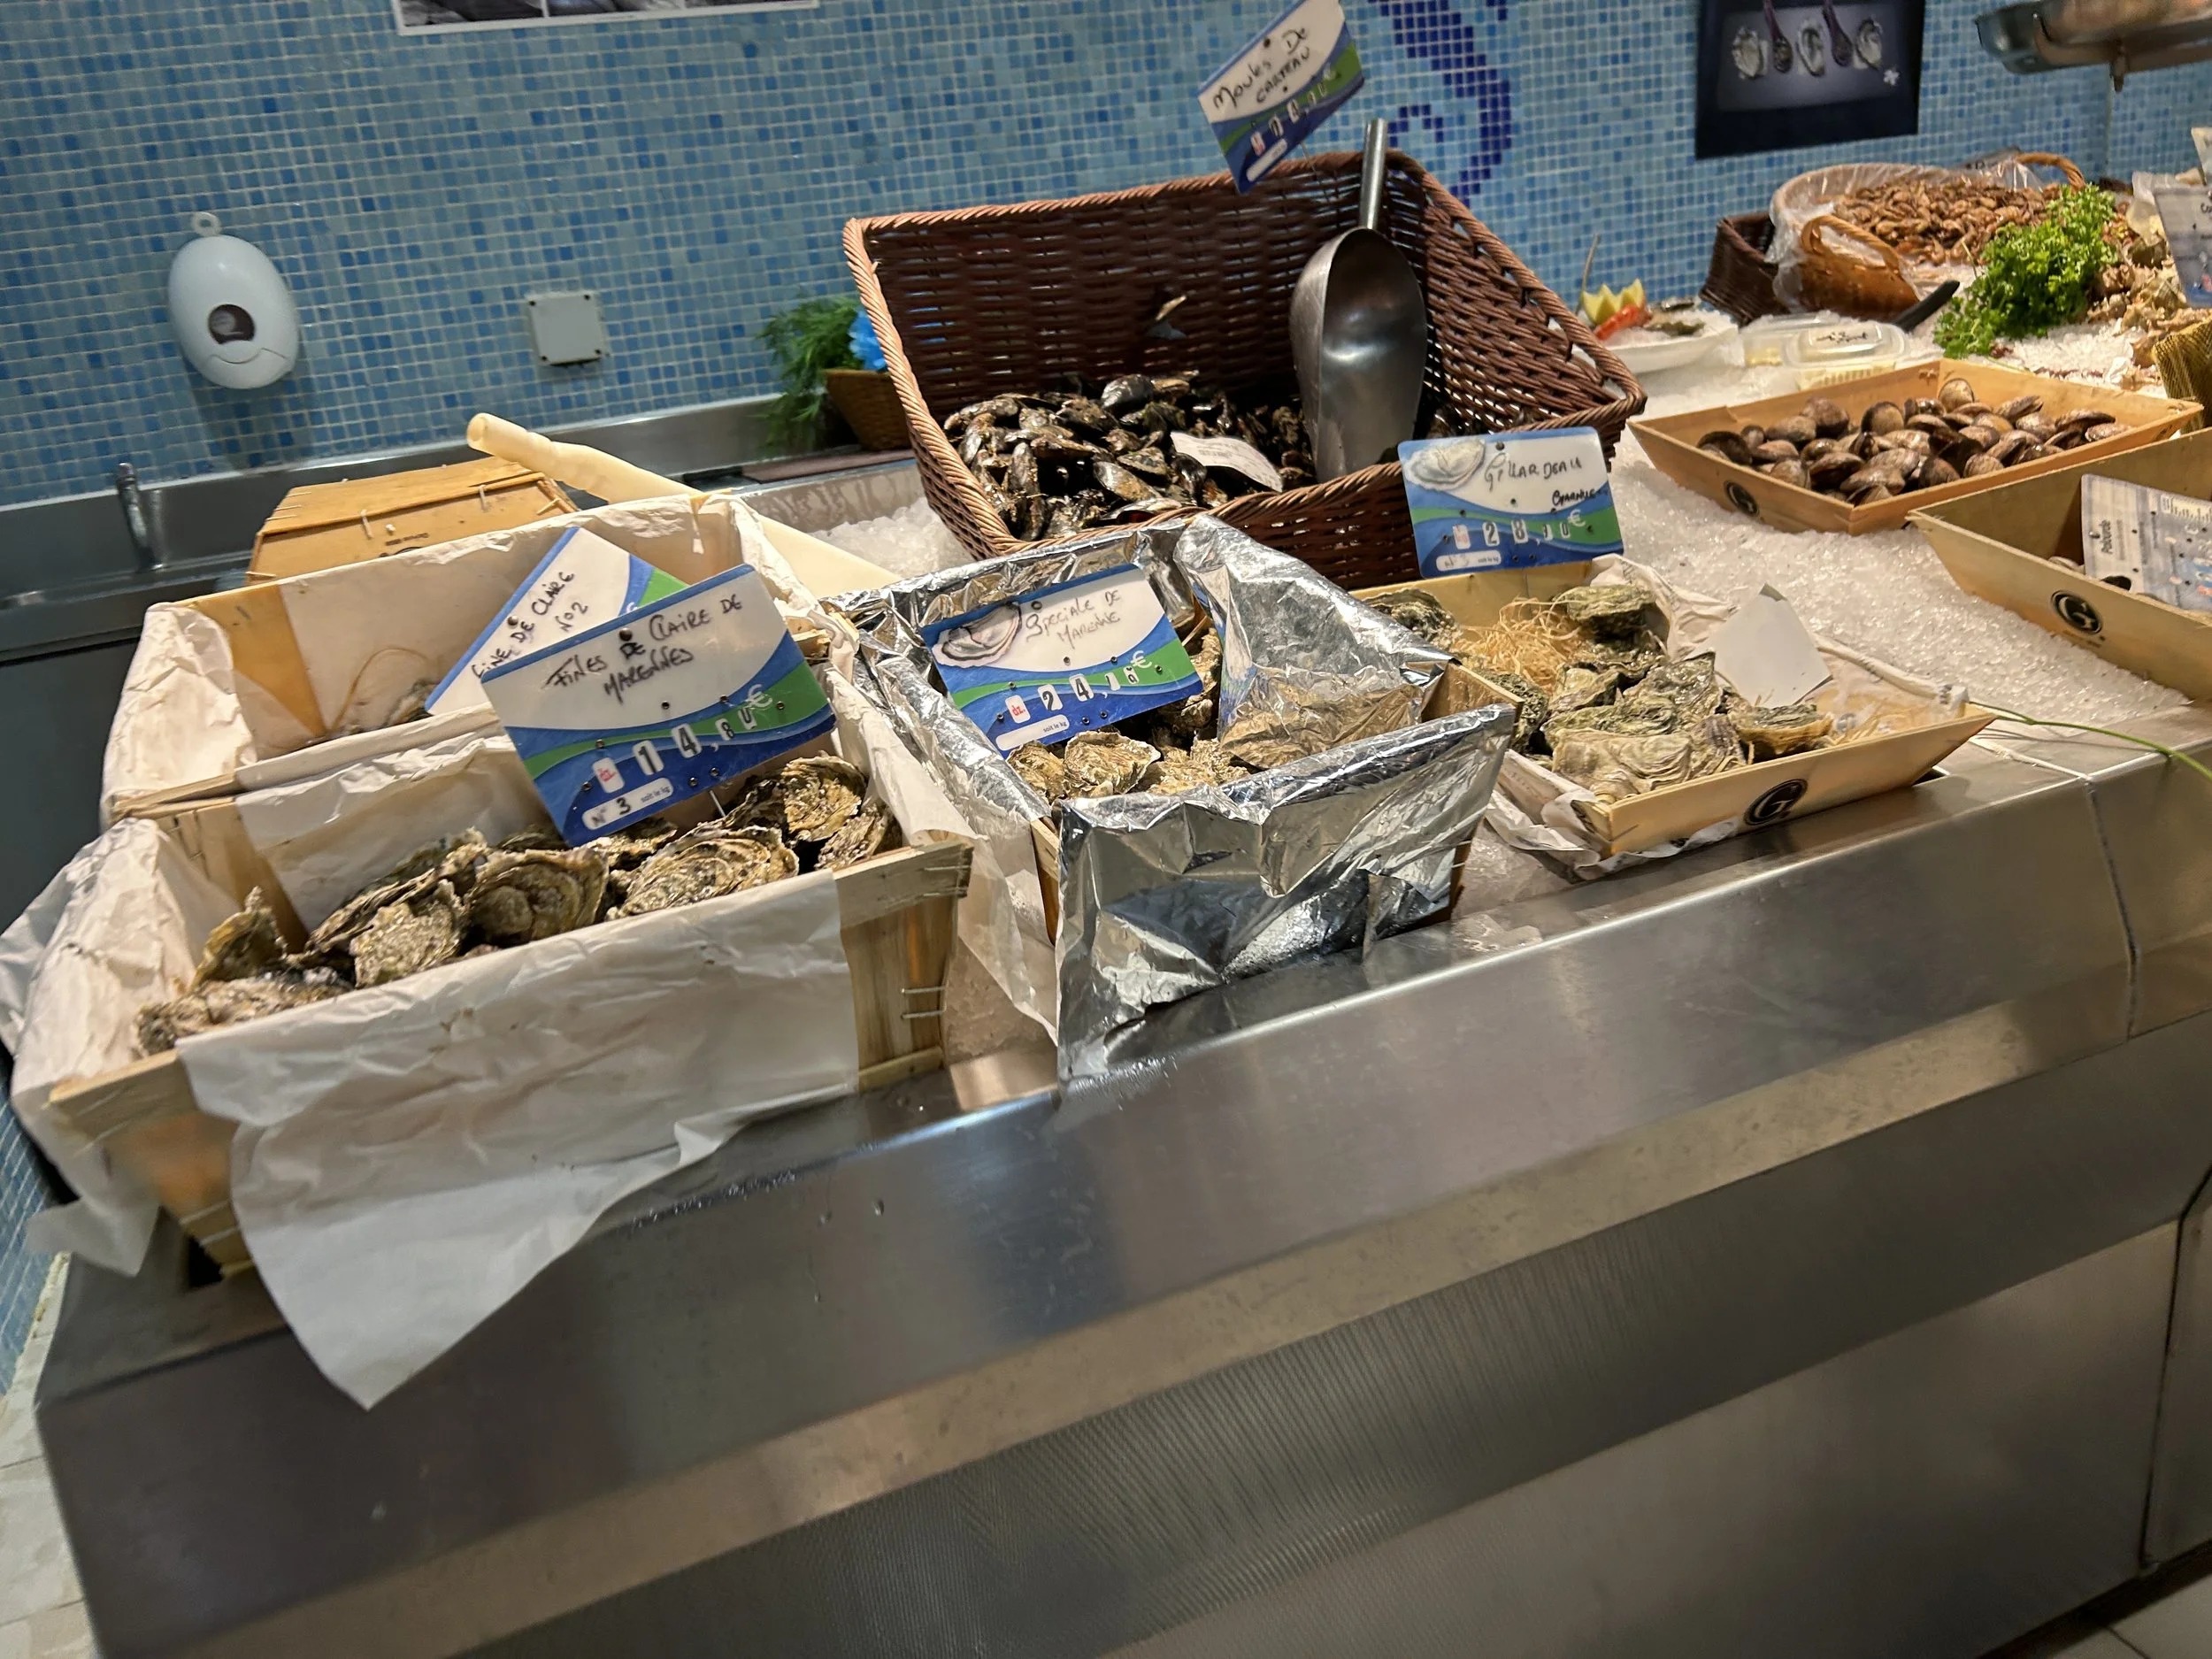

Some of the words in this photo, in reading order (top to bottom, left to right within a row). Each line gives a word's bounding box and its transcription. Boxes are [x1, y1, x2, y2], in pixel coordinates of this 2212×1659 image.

[510, 621, 534, 643] DE
[620, 641, 646, 661] DE
[720, 595, 742, 613] DE
[617, 797, 631, 815] 3
